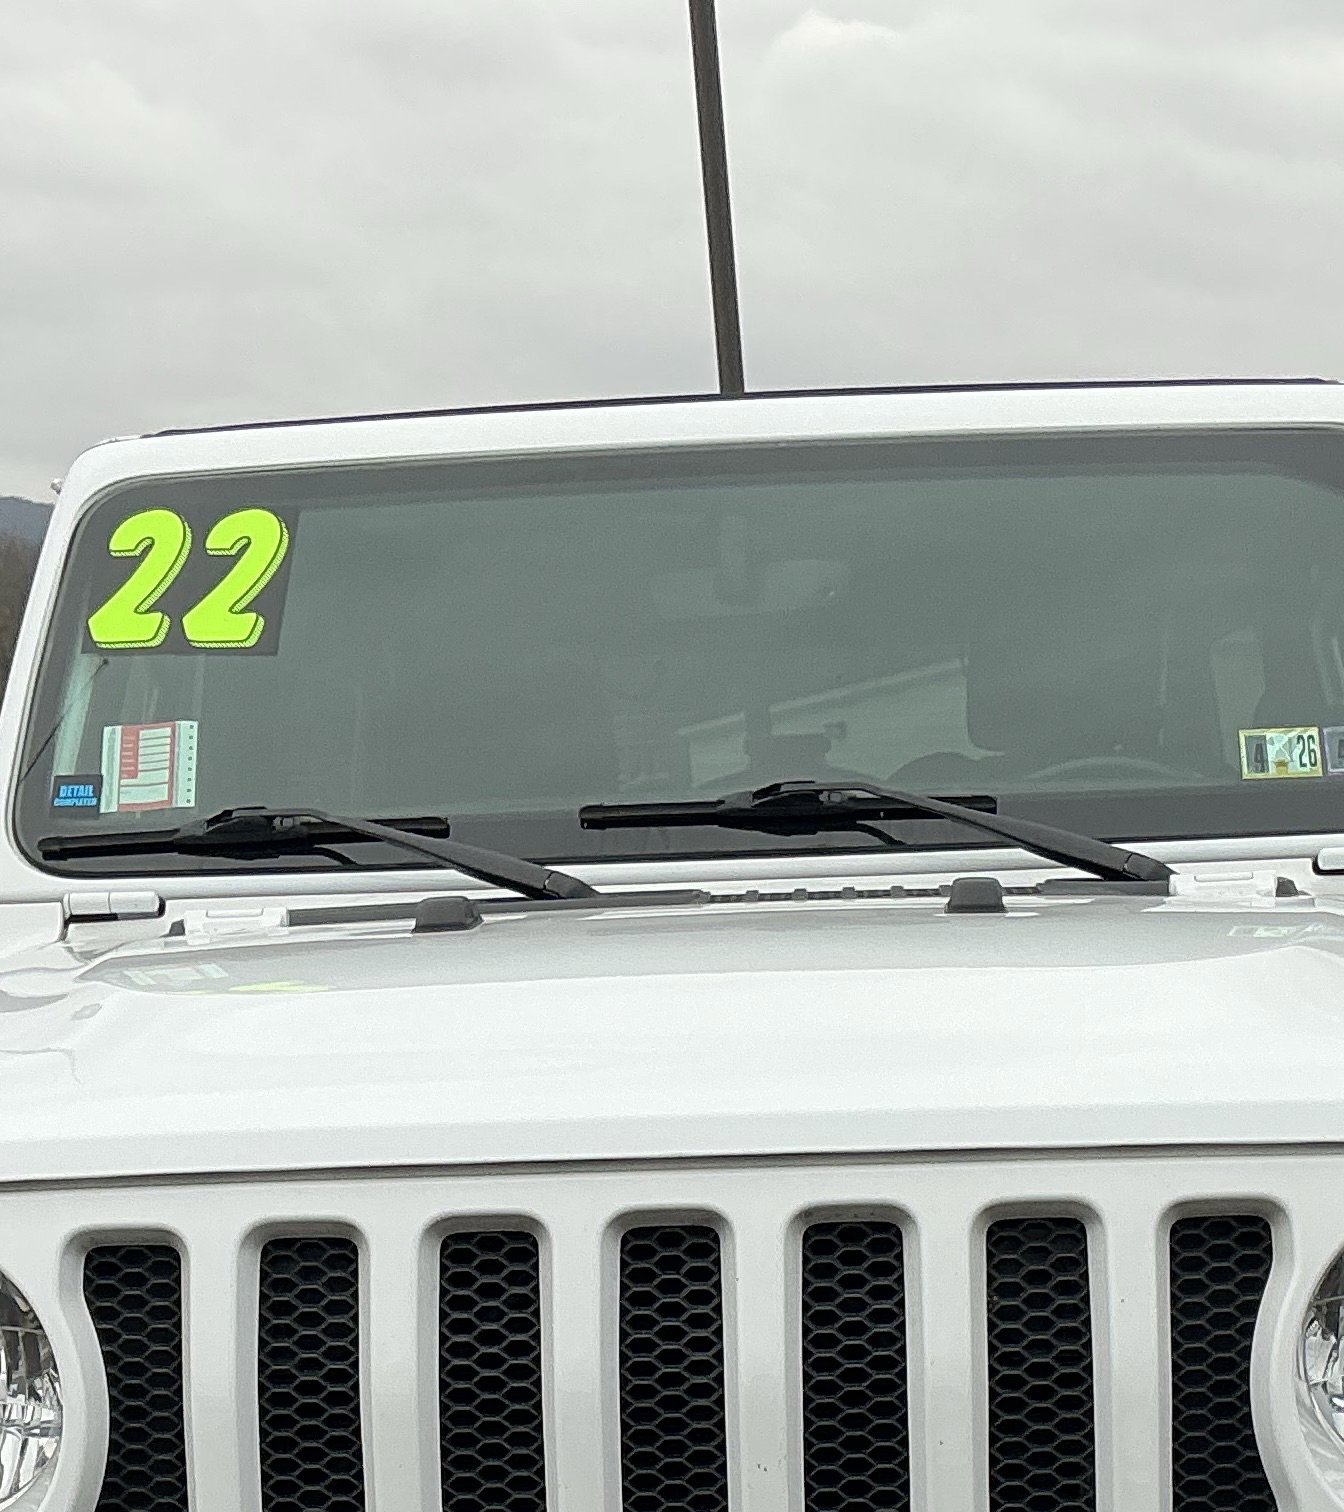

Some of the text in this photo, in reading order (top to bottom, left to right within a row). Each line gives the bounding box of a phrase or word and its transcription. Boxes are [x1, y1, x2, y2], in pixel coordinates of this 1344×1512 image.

[87, 508, 289, 648] 22
[1296, 734, 1318, 768] 26
[59, 784, 93, 798] DETAIL
